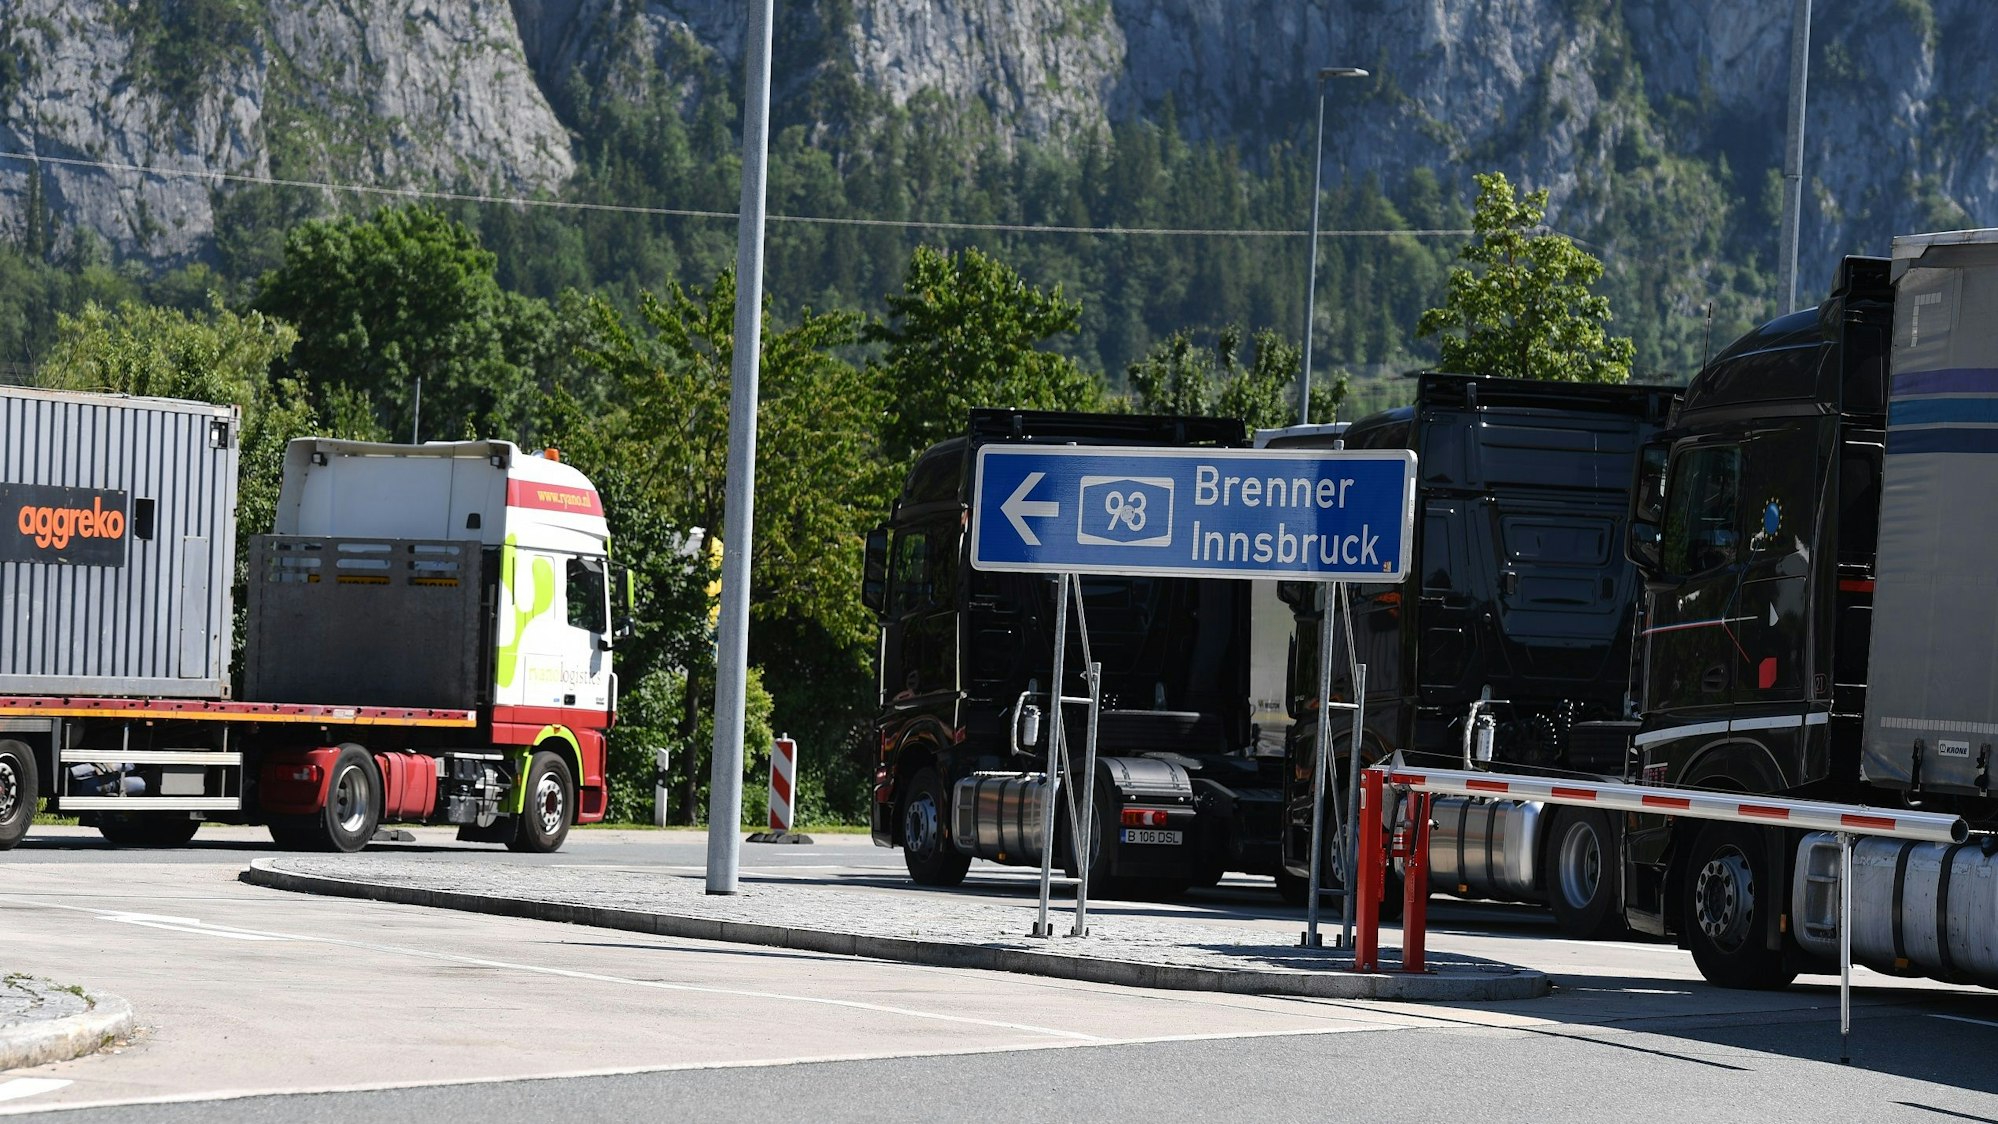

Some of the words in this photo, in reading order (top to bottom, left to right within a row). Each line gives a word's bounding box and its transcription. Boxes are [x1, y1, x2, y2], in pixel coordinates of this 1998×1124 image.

[536, 490, 592, 509] www.ryano.nl
[1194, 465, 1355, 509] Brenner
[18, 496, 125, 550] aggreko
[1105, 491, 1147, 532] 93
[1191, 520, 1380, 566] Innsbruck
[1946, 746, 1968, 755] KRONE
[1128, 831, 1136, 842] B
[1139, 831, 1155, 843] 106
[1158, 832, 1179, 844] DSL
